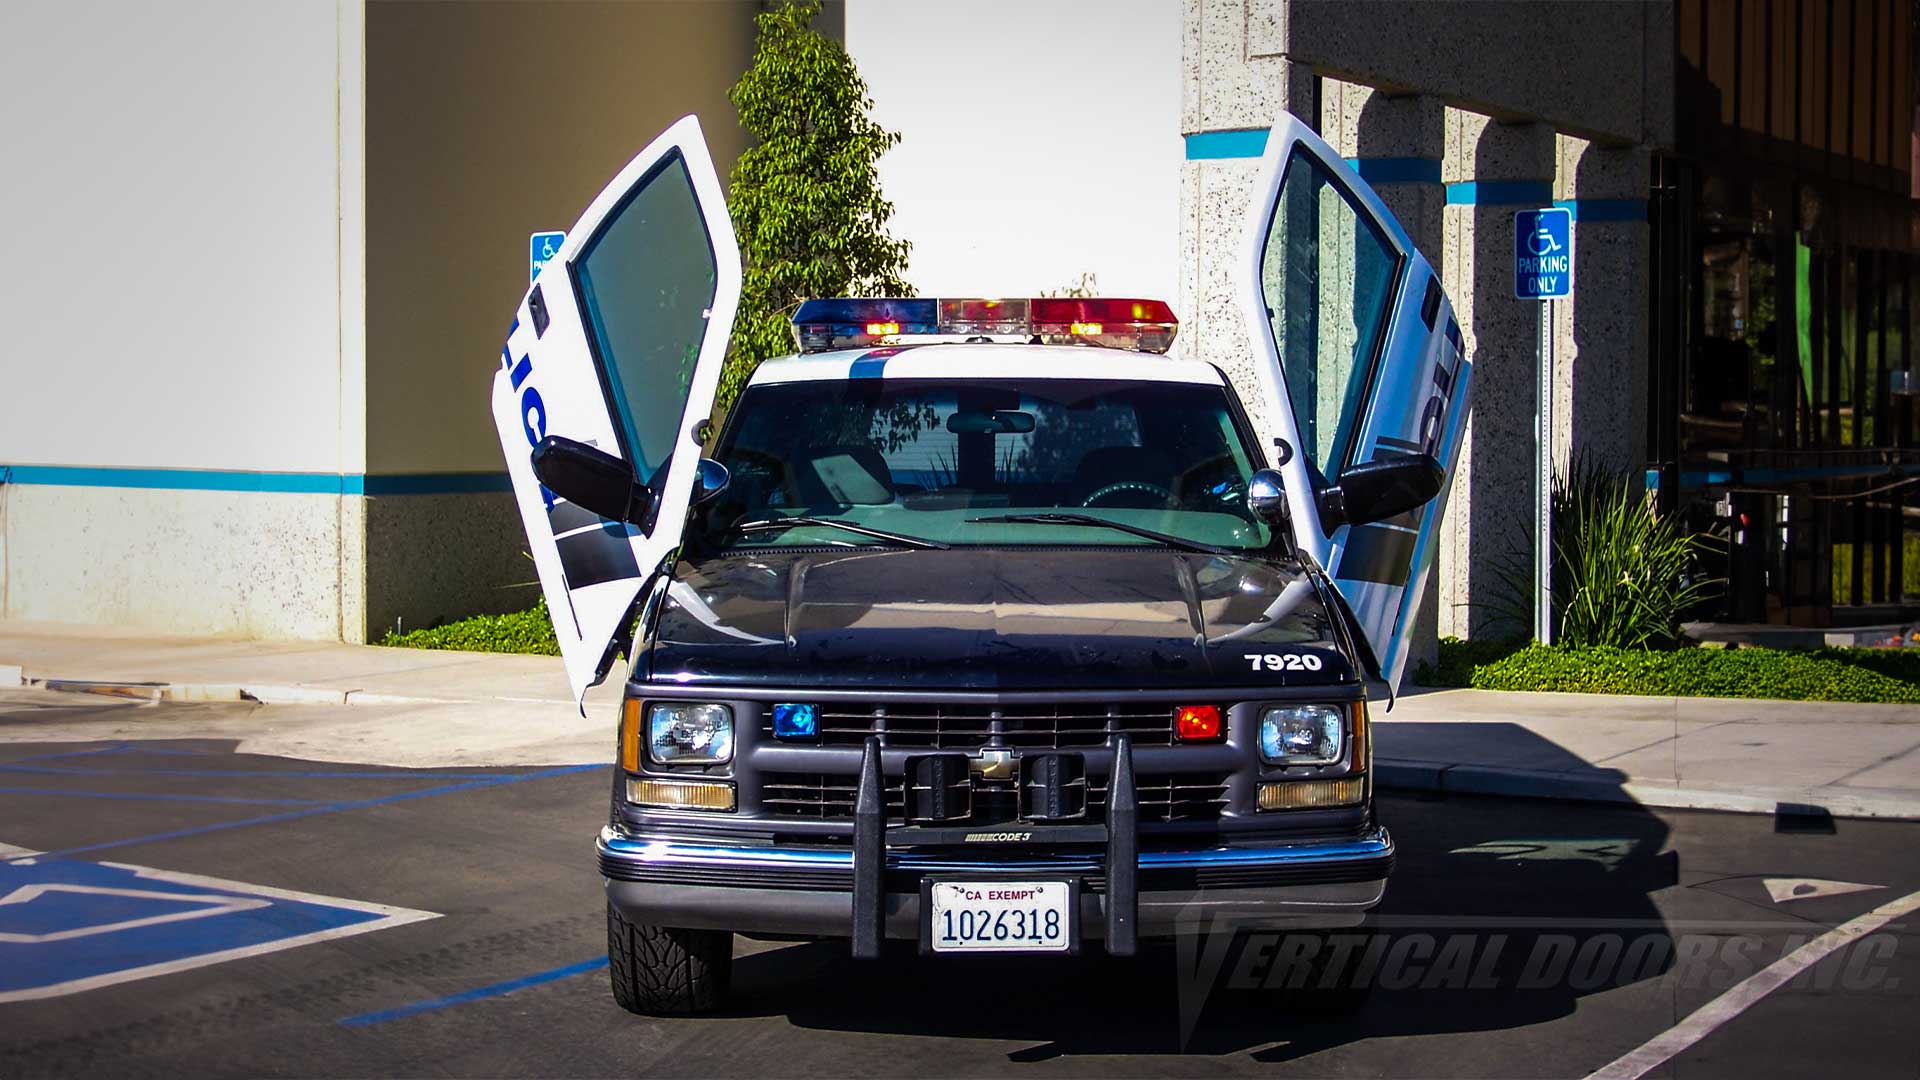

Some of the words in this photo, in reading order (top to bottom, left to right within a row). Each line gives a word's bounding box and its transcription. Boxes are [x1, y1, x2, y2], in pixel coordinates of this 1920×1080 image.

[1519, 255, 1568, 273] PARKING
[1528, 276, 1558, 294] ONLY
[1243, 654, 1323, 671] 7920
[992, 832, 1023, 842] CODE
[1022, 832, 1033, 841] 3
[965, 890, 982, 900] CA
[988, 890, 1036, 900] EXEMPT
[942, 909, 1060, 941] 1026318
